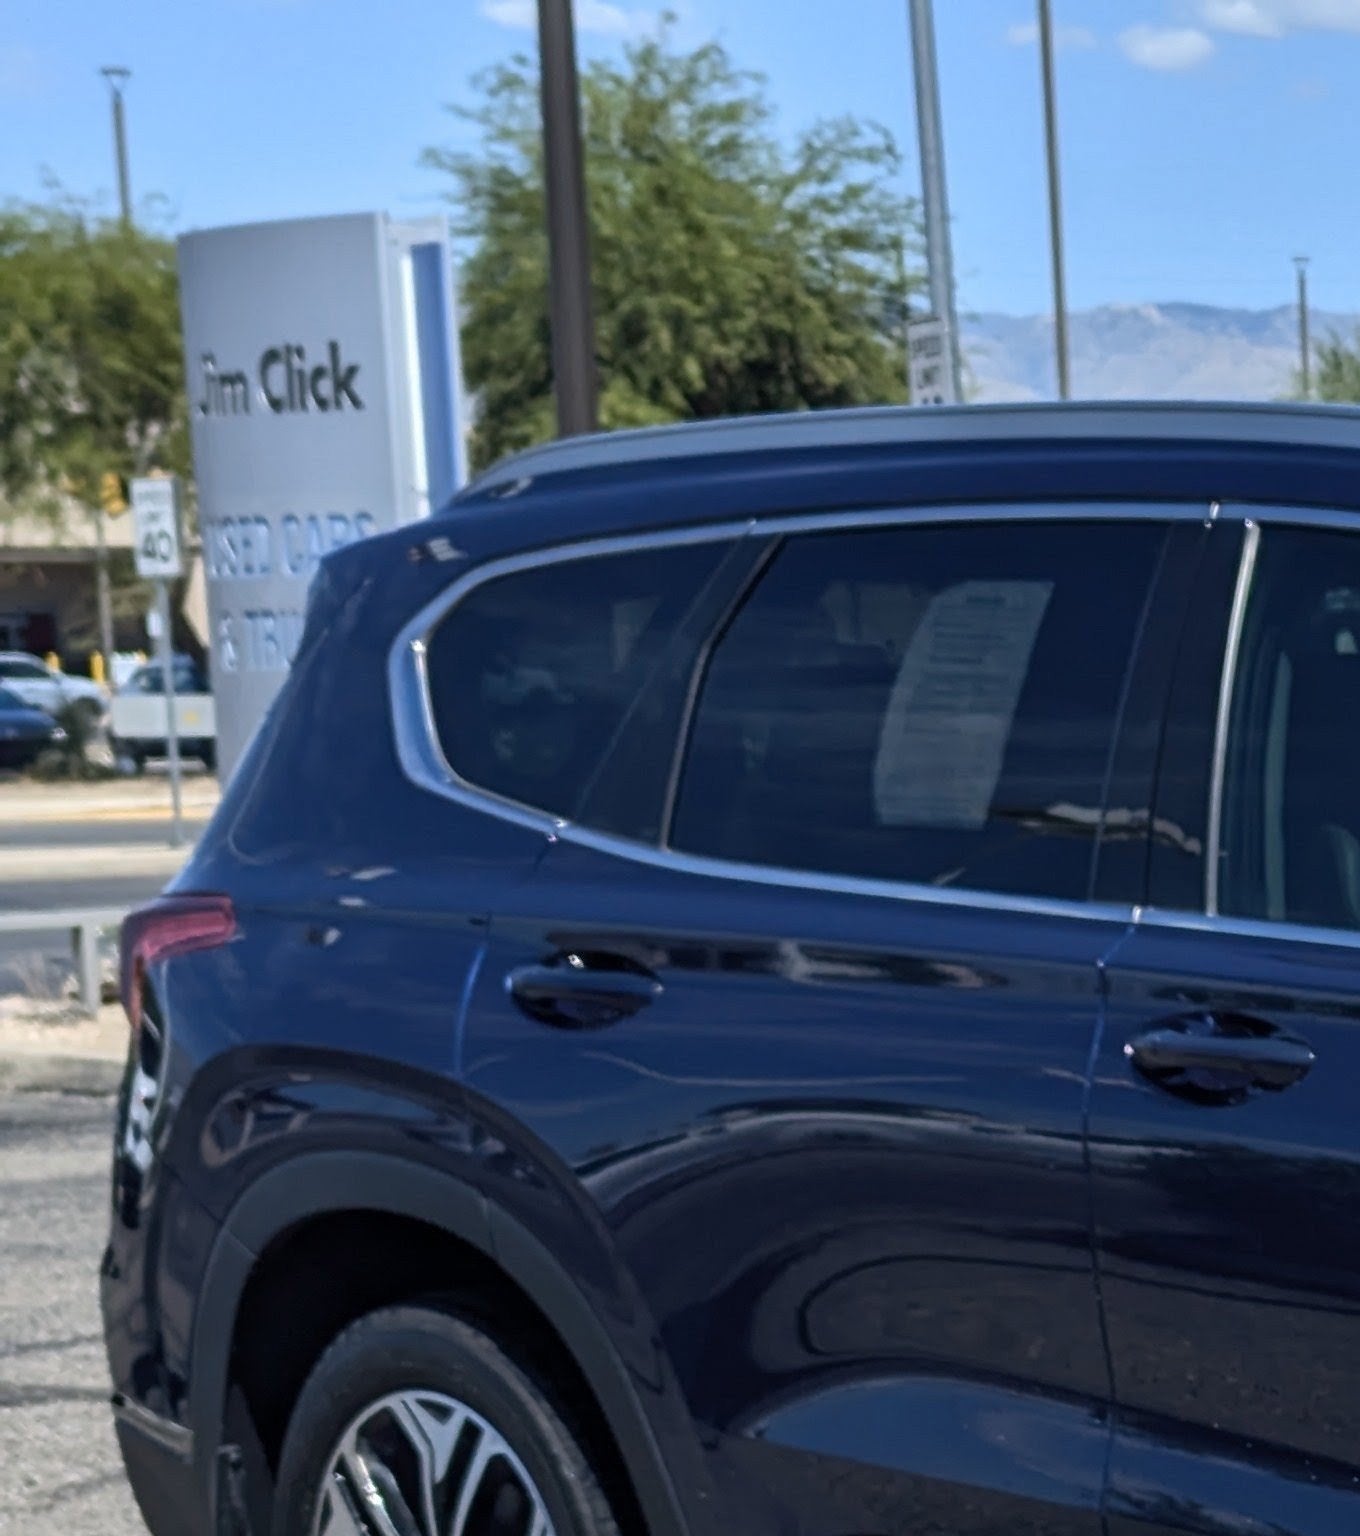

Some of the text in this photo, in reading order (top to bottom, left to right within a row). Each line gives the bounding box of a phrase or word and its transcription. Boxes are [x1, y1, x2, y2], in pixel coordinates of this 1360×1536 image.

[198, 340, 365, 416] Jim Click
[142, 530, 173, 563] 40
